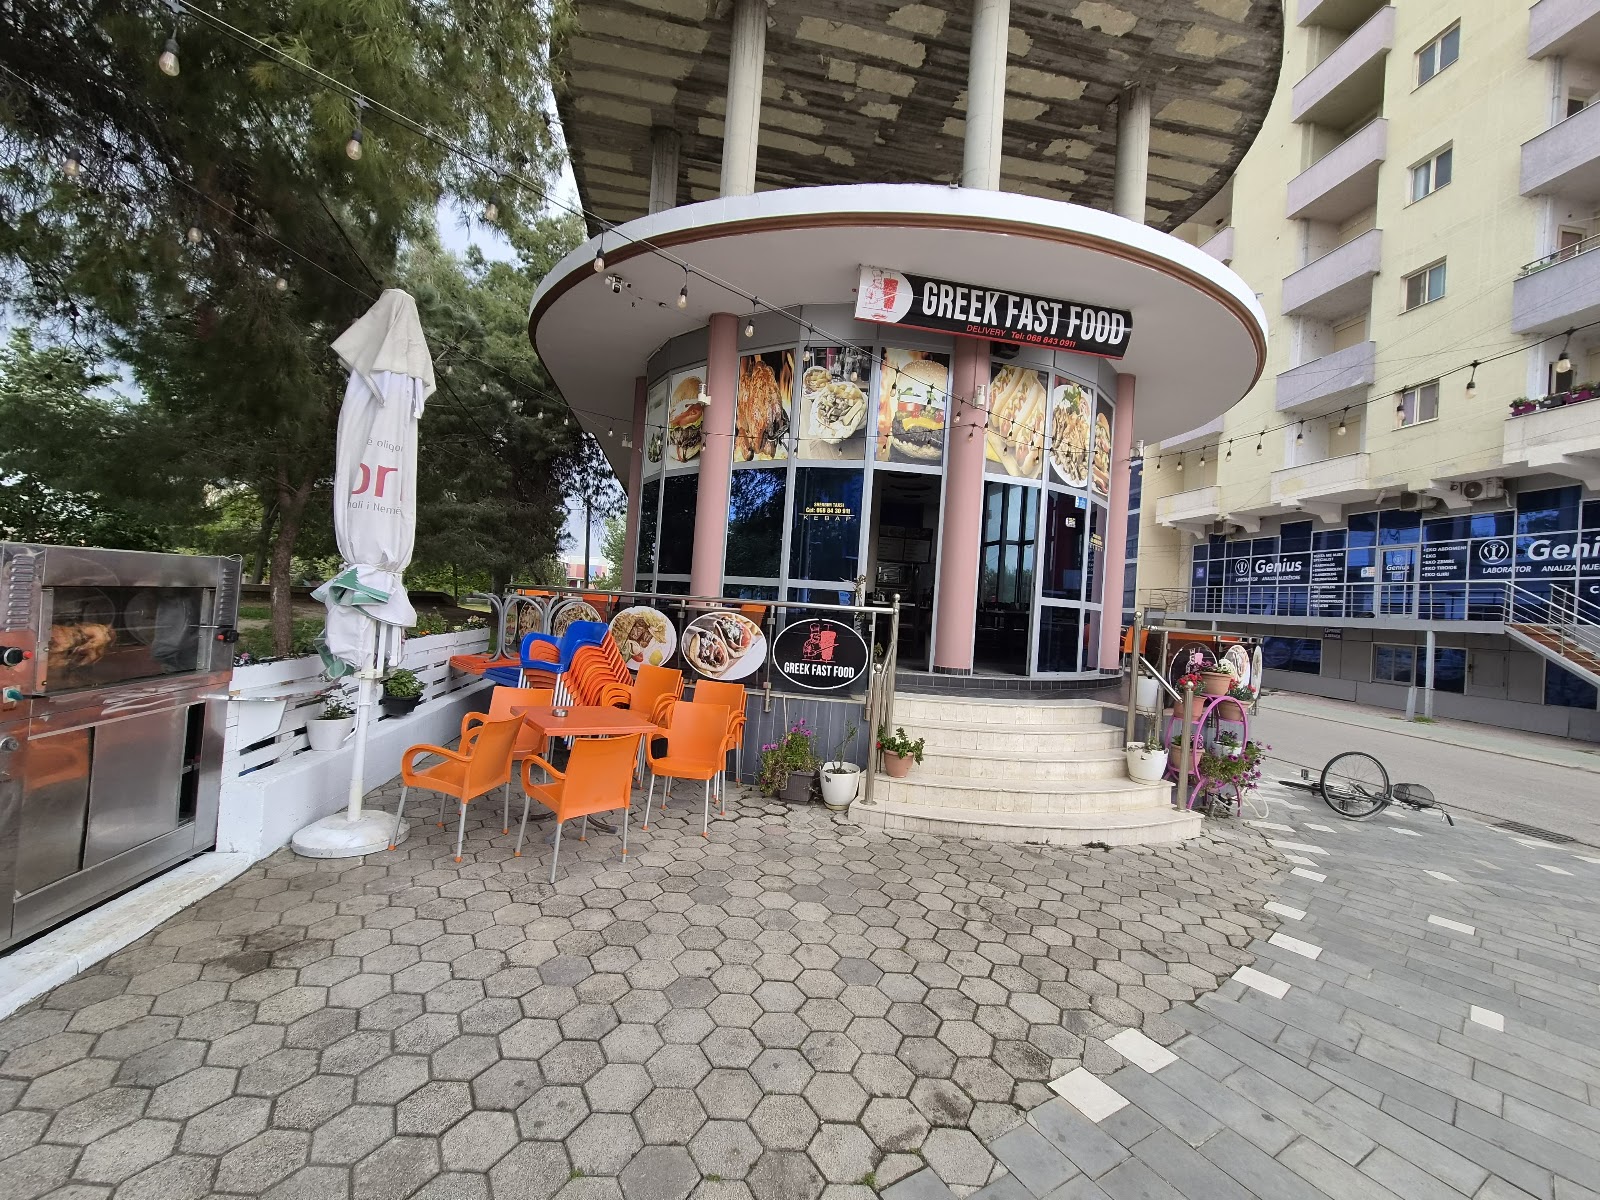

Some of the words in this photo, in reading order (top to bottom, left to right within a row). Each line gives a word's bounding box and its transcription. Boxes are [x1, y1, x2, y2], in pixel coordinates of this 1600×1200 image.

[922, 281, 1000, 326] GREEK
[1005, 292, 1063, 335] FAST
[1068, 306, 1126, 346] FOOD
[966, 324, 1007, 337] DELIVERY
[1011, 331, 1025, 341] Tel:
[1026, 333, 1042, 344] 068
[1042, 336, 1058, 347] 843
[1059, 338, 1077, 348] 0911
[1255, 557, 1303, 574] Genius
[1482, 565, 1532, 574] LABORATOR
[1541, 565, 1577, 573] ANALIZA
[1581, 563, 1600, 571] MJE
[784, 661, 811, 675] GREEK
[811, 664, 832, 677] FAST
[833, 666, 855, 679] FOOD
